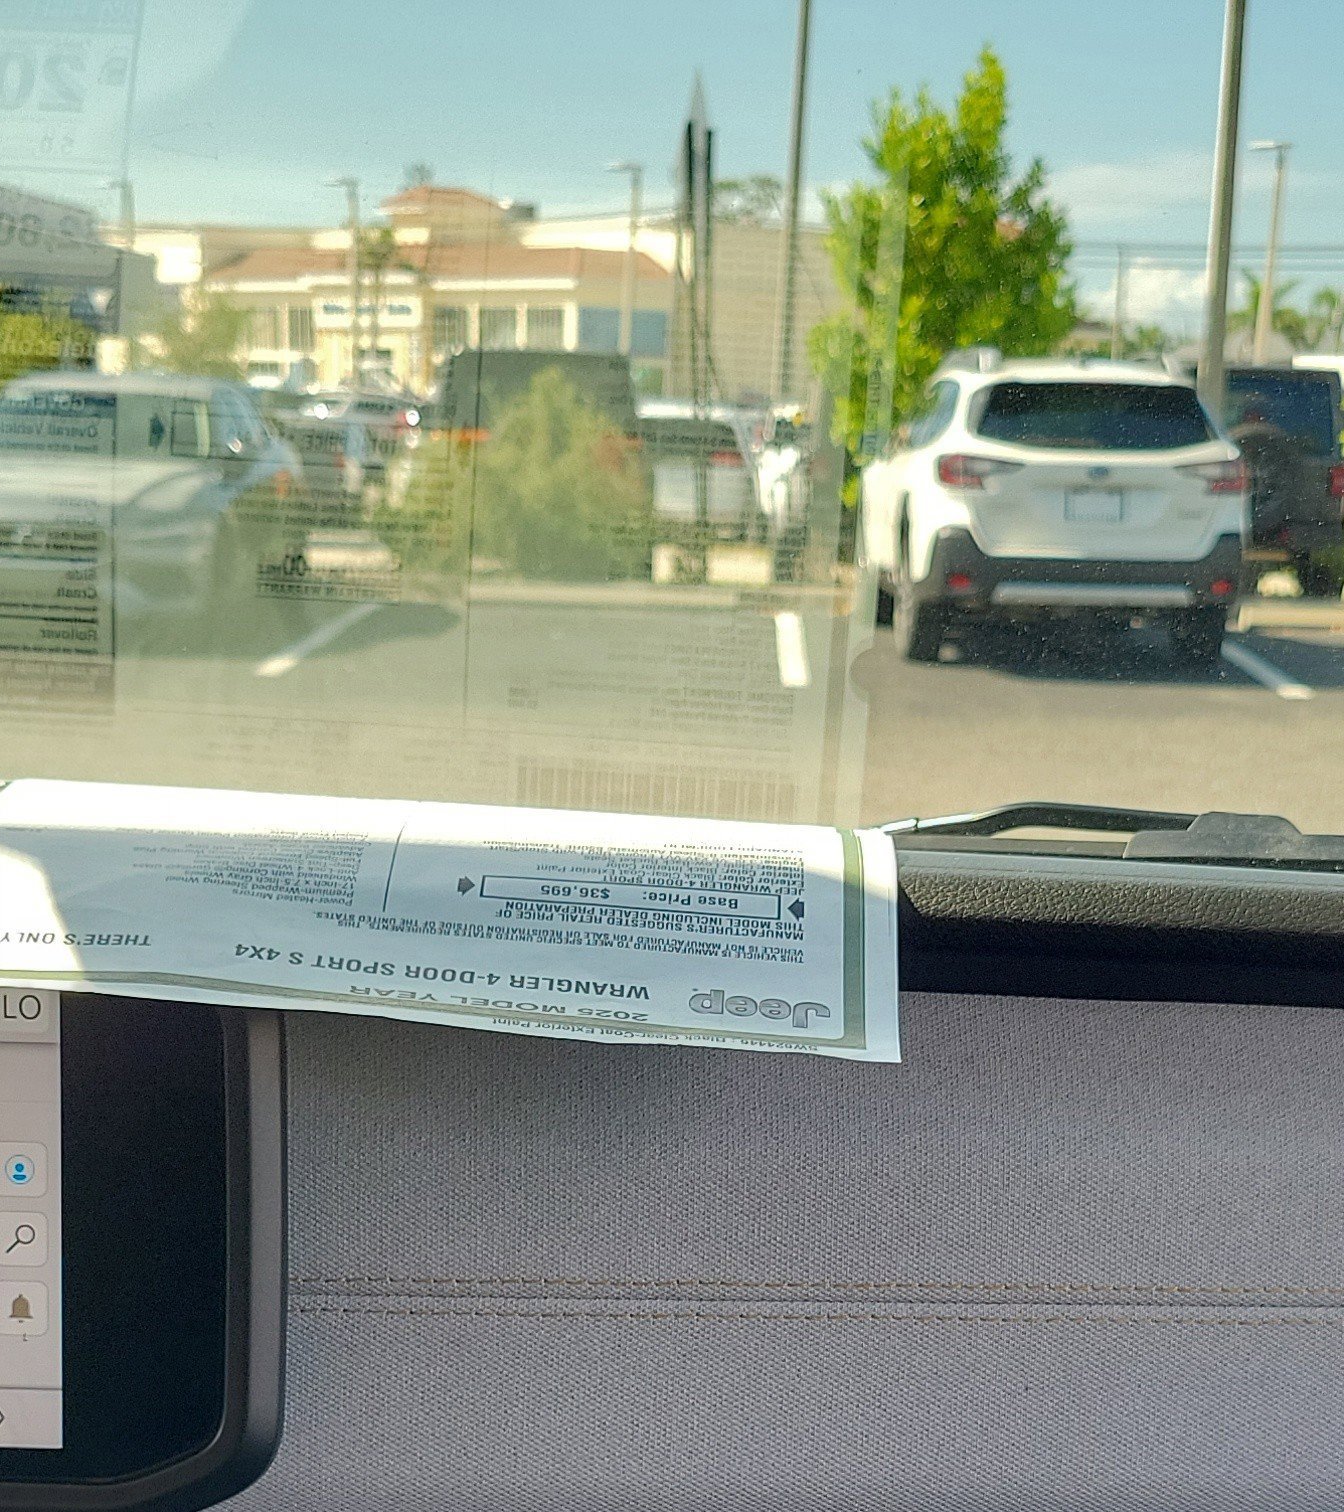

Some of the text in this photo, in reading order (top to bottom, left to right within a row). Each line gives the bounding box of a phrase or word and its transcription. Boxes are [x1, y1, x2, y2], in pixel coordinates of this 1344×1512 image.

[540, 884, 611, 900] $36,695
[602, 875, 805, 896] JEEP WRANGLER 4-DOOR SPORT
[642, 891, 738, 909] Base Price:
[505, 901, 804, 932] THIS MODEL INCLUDING DEALER PREPARATION
[337, 920, 361, 929] THIS
[495, 909, 804, 941] MANUFACTURER'S SUGGESTED RETAIL PRICE OF
[0, 931, 56, 945] ONLY
[63, 932, 151, 947] THERE'S
[454, 929, 493, 940] STATES
[495, 933, 534, 943] UNITED
[536, 936, 583, 946] SPECIFIC
[585, 939, 614, 948] MEET
[616, 941, 631, 950] TO
[634, 943, 718, 957] MANUFACTURED
[735, 951, 776, 961] VEHICLE
[780, 954, 804, 964] THIS
[235, 944, 650, 1000] WRANGLER 4-DOOR SPORT S 4X4
[2, 992, 42, 1022] LO
[349, 985, 649, 1022] 2025 MODEL YEAR
[688, 989, 831, 1029] Jeep
